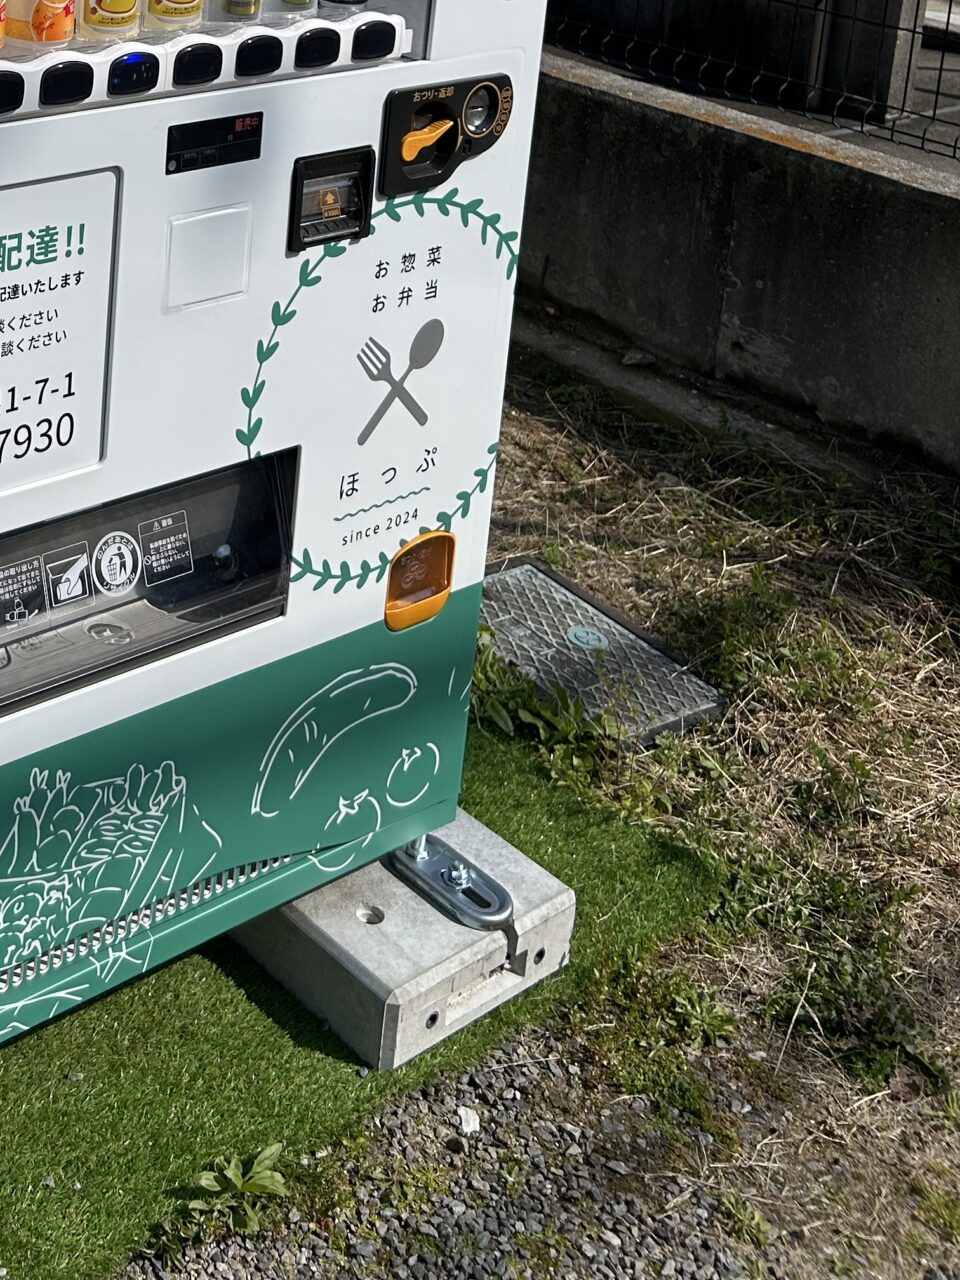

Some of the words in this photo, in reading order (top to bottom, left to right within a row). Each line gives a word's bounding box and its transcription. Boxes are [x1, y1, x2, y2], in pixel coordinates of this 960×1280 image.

[412, 85, 455, 103] おつり・返却
[374, 246, 442, 279] お惣菜
[371, 278, 439, 313] お弁当
[341, 524, 380, 546] since
[386, 508, 419, 531] 2024
[97, 535, 134, 560] のんだあとは
[103, 572, 136, 591] リサイクル
